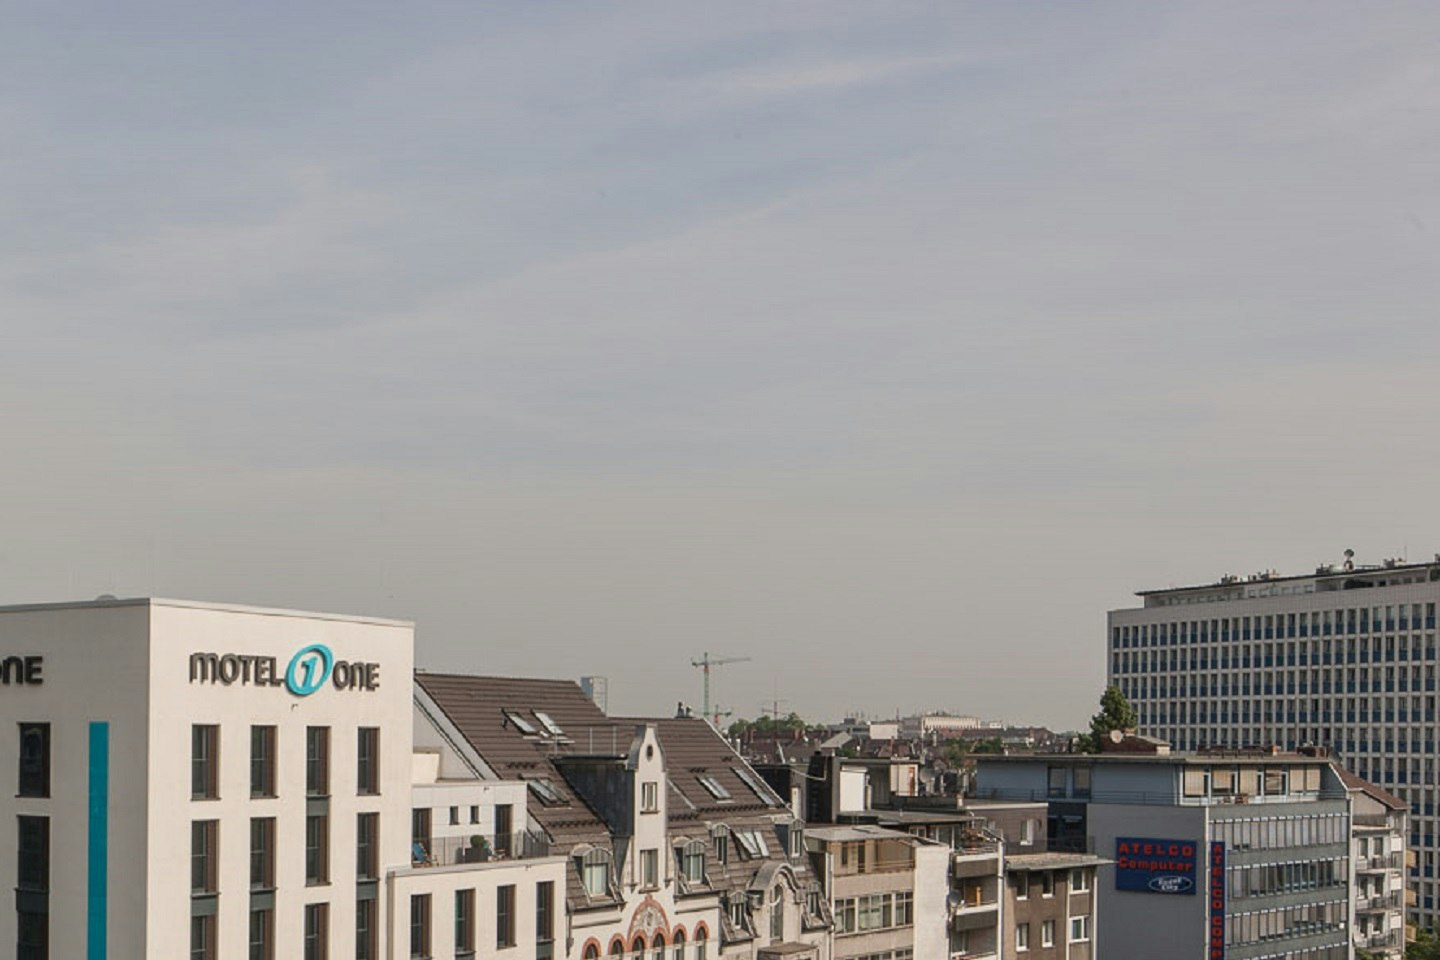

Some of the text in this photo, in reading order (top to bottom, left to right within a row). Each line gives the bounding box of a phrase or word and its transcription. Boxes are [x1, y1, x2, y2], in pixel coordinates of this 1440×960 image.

[189, 652, 286, 687] MOTEL
[332, 660, 380, 692] ONE
[1120, 842, 1192, 857] ATELCO
[1119, 857, 1192, 872] Computer
[1211, 843, 1224, 909] ATELCO
